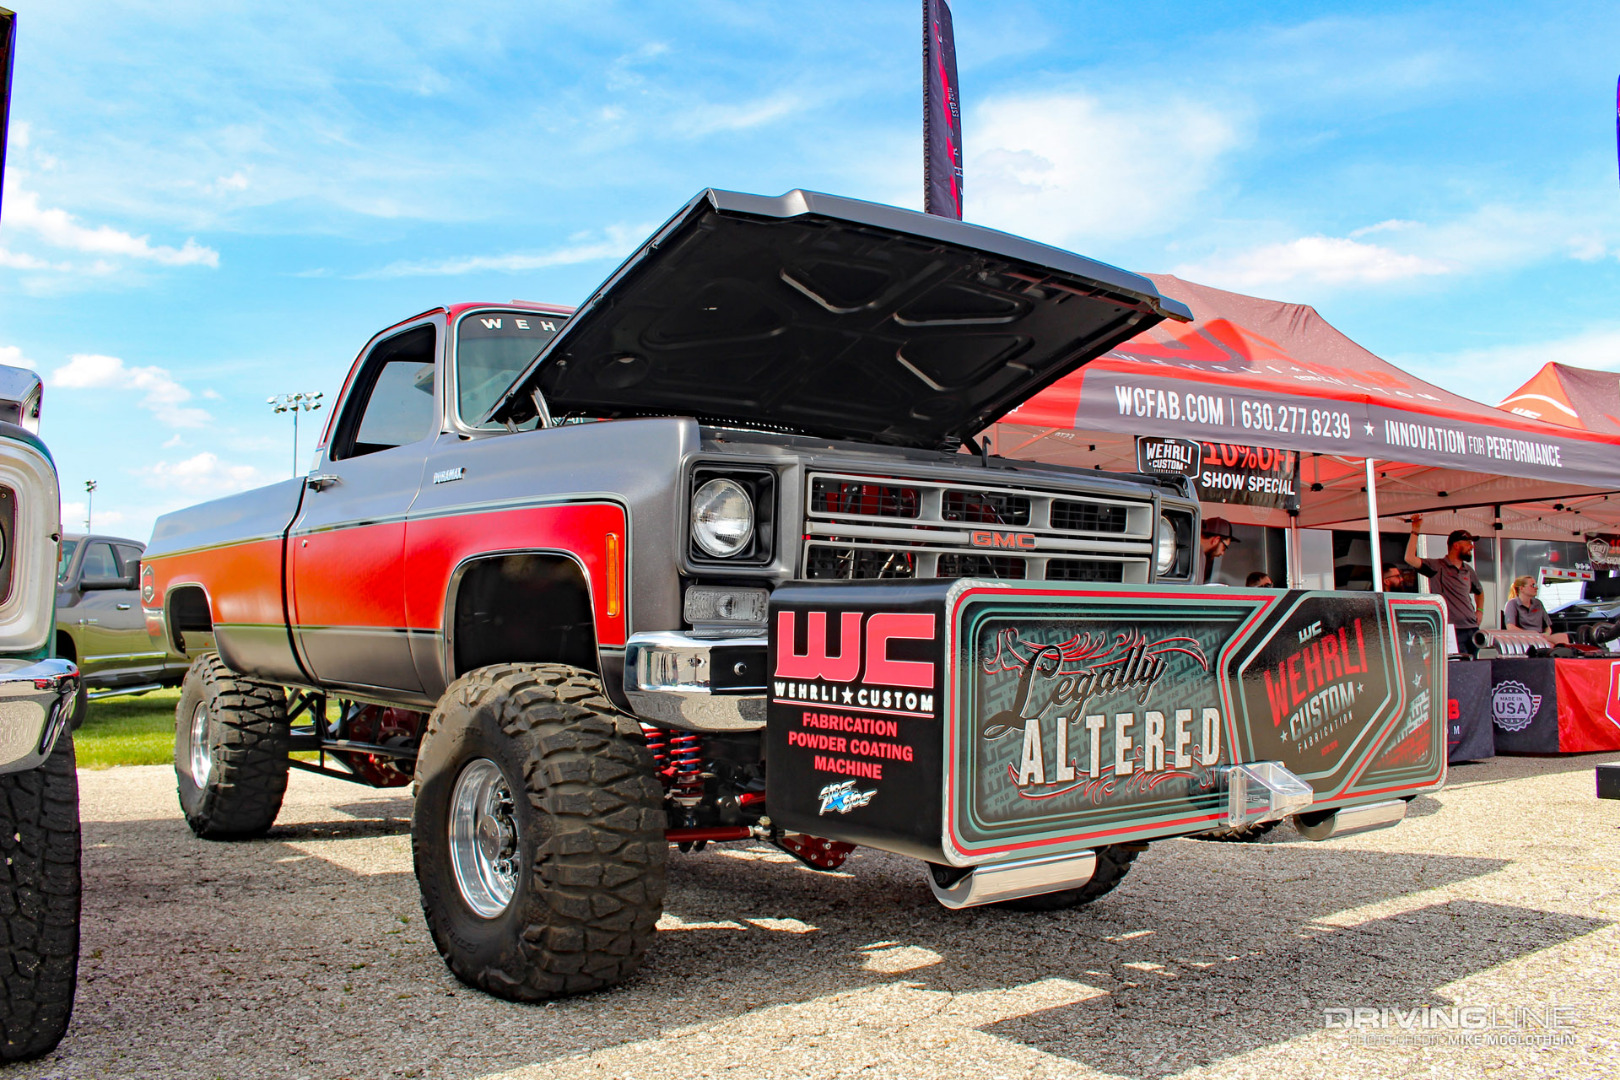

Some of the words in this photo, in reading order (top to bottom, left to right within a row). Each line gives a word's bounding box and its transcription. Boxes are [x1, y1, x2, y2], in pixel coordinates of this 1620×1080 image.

[1115, 385, 1225, 426] WCFAB.COM
[1241, 400, 1351, 440] 630.277.8239
[1146, 442, 1192, 464] WEHRLI
[1384, 420, 1466, 455] INNOVATION
[1468, 435, 1486, 456] FOR
[1487, 435, 1563, 468] PERFORMANCE
[1152, 459, 1184, 471] CUSTOM
[1201, 471, 1246, 490] SHOW
[1247, 476, 1296, 496] SPECIAL
[971, 530, 1037, 549] GMC
[1298, 620, 1322, 643] WC
[774, 611, 935, 688] WC
[1263, 617, 1368, 728] WEHRLI
[773, 681, 837, 703] WEHRLI
[857, 688, 934, 712] CUSTOM
[983, 644, 1168, 741] Legally
[1495, 702, 1528, 714] USA
[802, 712, 898, 738] FABRICATION
[1289, 681, 1355, 742] CUSTOM
[788, 731, 847, 753] POWDER
[849, 739, 914, 763] COATING
[1018, 707, 1222, 786] ALTERED
[1297, 710, 1354, 754] FABRICATION
[814, 755, 883, 780] MACHINE
